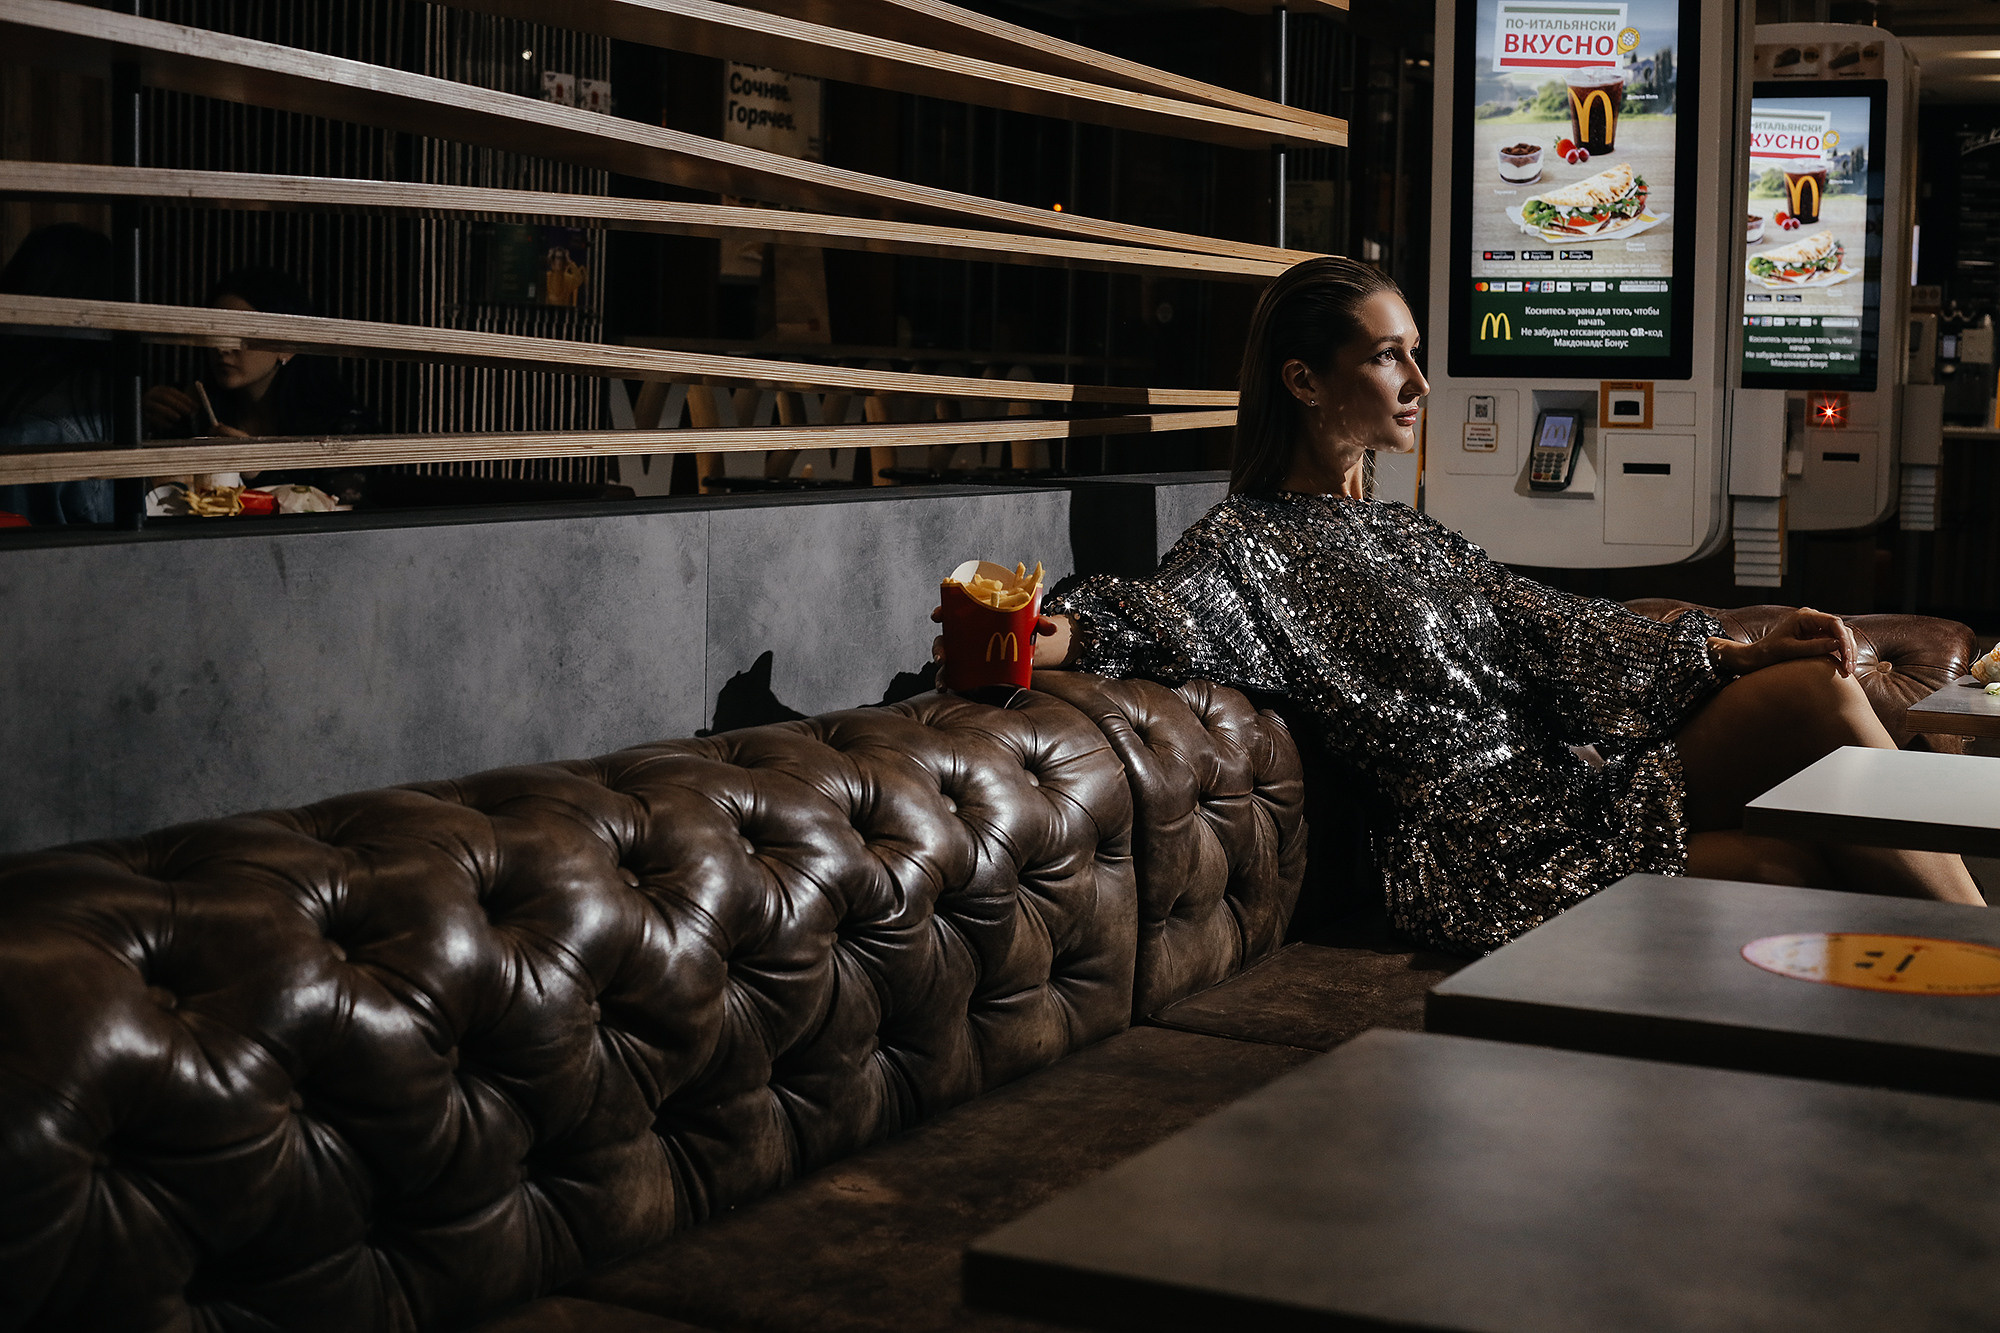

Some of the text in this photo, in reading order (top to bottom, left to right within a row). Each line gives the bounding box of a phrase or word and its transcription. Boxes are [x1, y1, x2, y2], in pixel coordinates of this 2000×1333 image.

[1505, 18, 1616, 32] ПО-ИТАЛЬЯНСКИ
[1504, 33, 1614, 56] ВКУСНО
[1750, 132, 1820, 150] КУСНО
[1524, 306, 1660, 317] Коснитесь экрана для того, чтобы
[1577, 317, 1606, 327] начать
[1521, 327, 1663, 338] Не забудьте отсканировать QR-код
[1553, 338, 1629, 349] Макдоналдс Бонус
